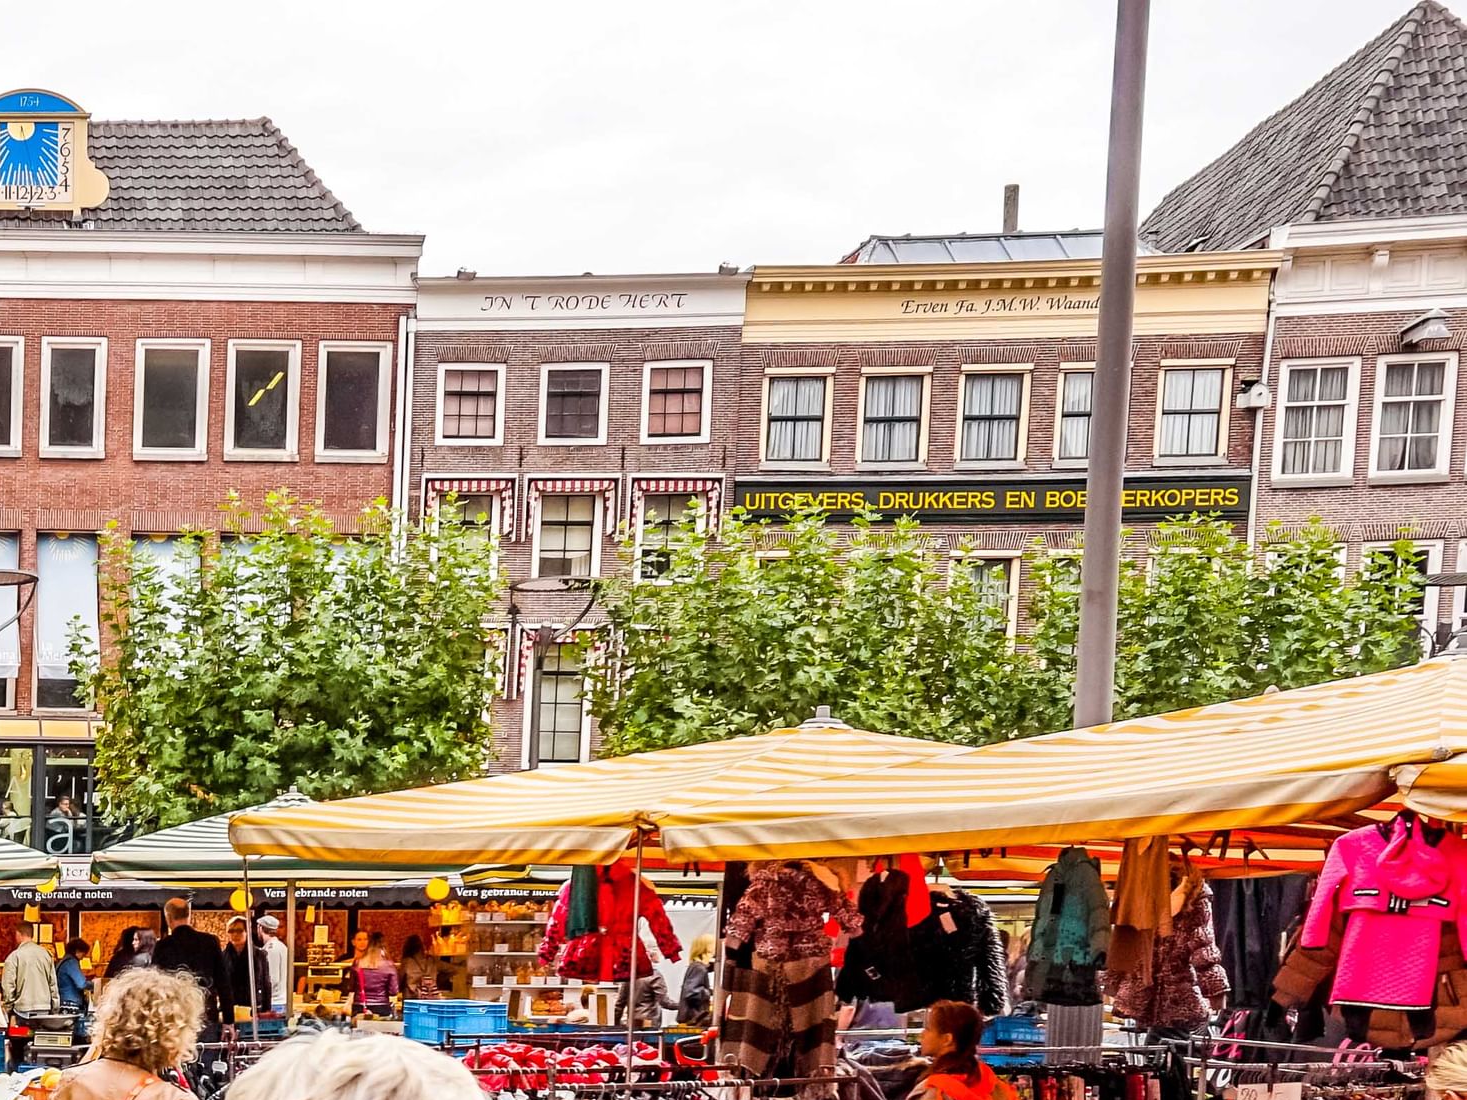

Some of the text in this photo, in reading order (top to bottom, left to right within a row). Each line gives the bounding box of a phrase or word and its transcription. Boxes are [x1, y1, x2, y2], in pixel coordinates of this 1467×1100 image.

[19, 96, 40, 108] 1754
[61, 127, 72, 139] 7
[59, 142, 71, 158] 6
[480, 295, 514, 311] IN
[546, 294, 611, 311] RODE
[618, 293, 688, 309] HERT
[900, 300, 950, 315] Erven
[953, 299, 977, 314] Fa.
[1045, 295, 1102, 311] Waand
[879, 490, 996, 510] DRUKKERS
[1004, 490, 1036, 508] EN
[1045, 488, 1240, 509] BOEERKOPERS
[11, 889, 33, 899] Vers
[84, 890, 113, 899] noten
[263, 887, 369, 898] Vers ebrande noten
[455, 887, 479, 897] Vers
